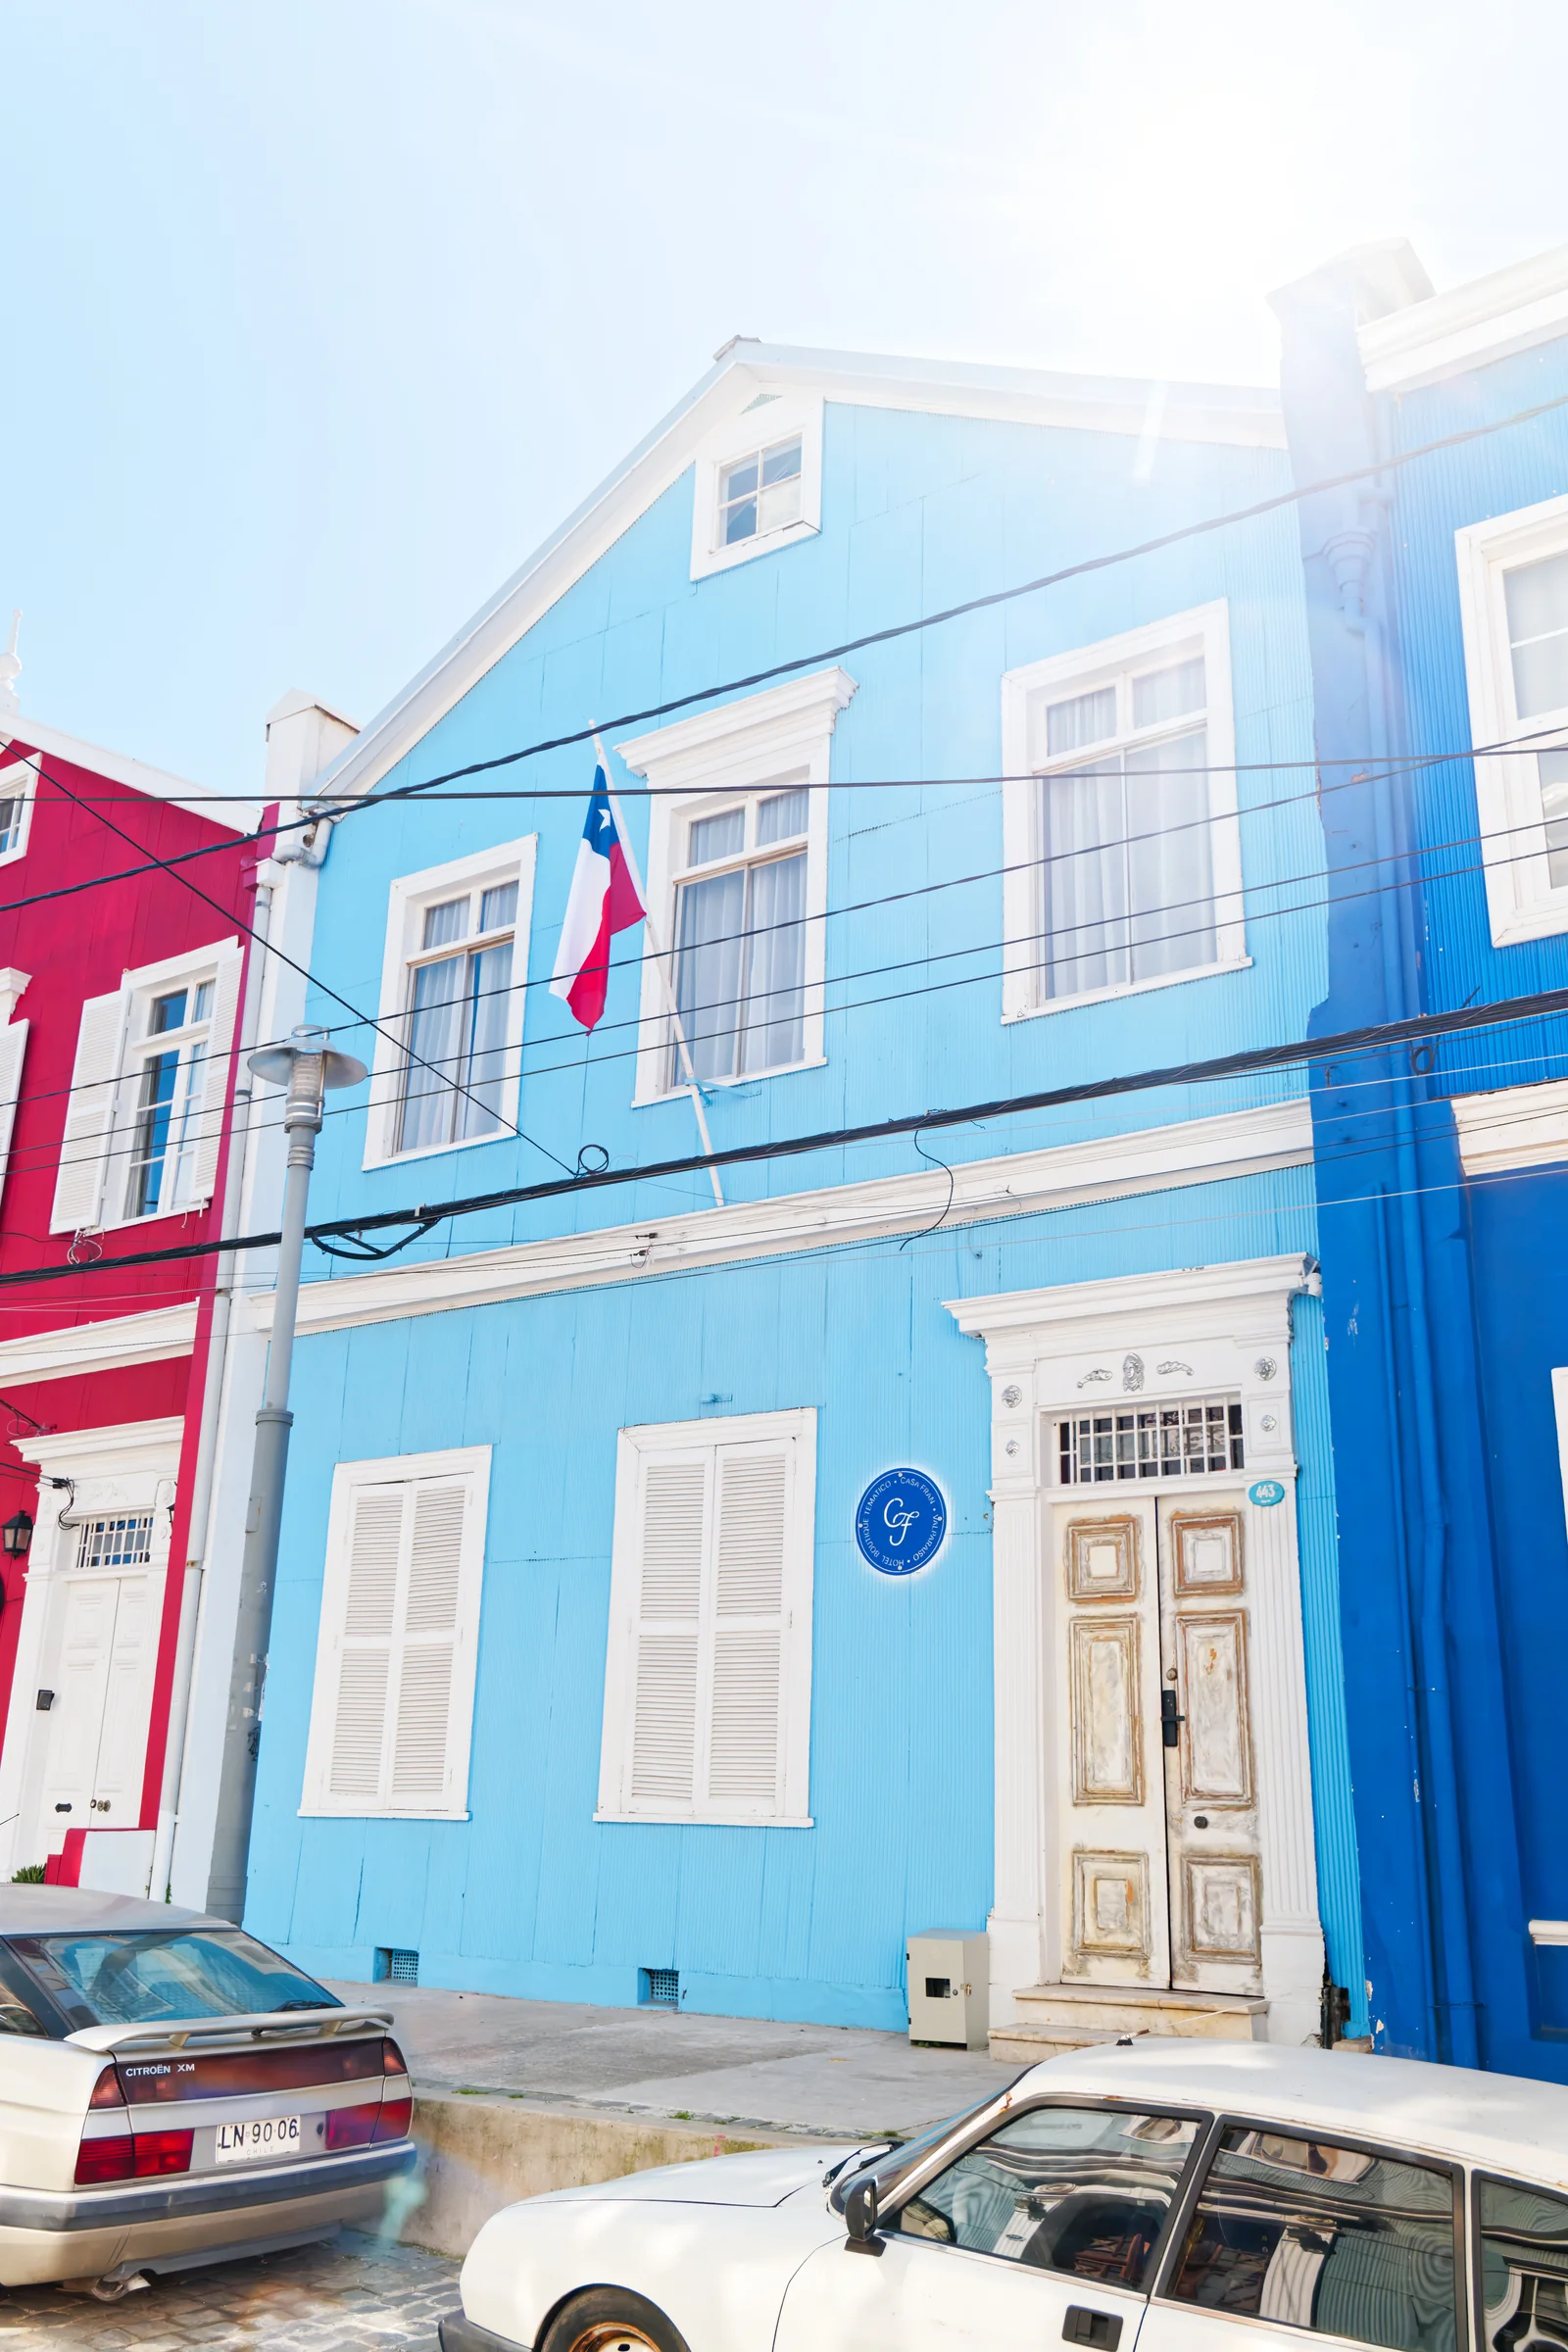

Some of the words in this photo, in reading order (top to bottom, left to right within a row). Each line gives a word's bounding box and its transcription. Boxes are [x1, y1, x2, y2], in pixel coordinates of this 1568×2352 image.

[863, 1480, 891, 1515] TEMATICO
[900, 1477, 919, 1488] CASA
[919, 1485, 936, 1504] FRAN
[1255, 1484, 1276, 1497] 443
[862, 1518, 880, 1558] BOUTIQUE
[912, 1514, 938, 1561] VALPARAISO
[881, 1554, 905, 1567] HOTEL
[125, 2064, 172, 2077] CITROËN
[177, 2063, 195, 2073] XM
[220, 2125, 244, 2149] LN
[246, 2146, 274, 2156] CHILE
